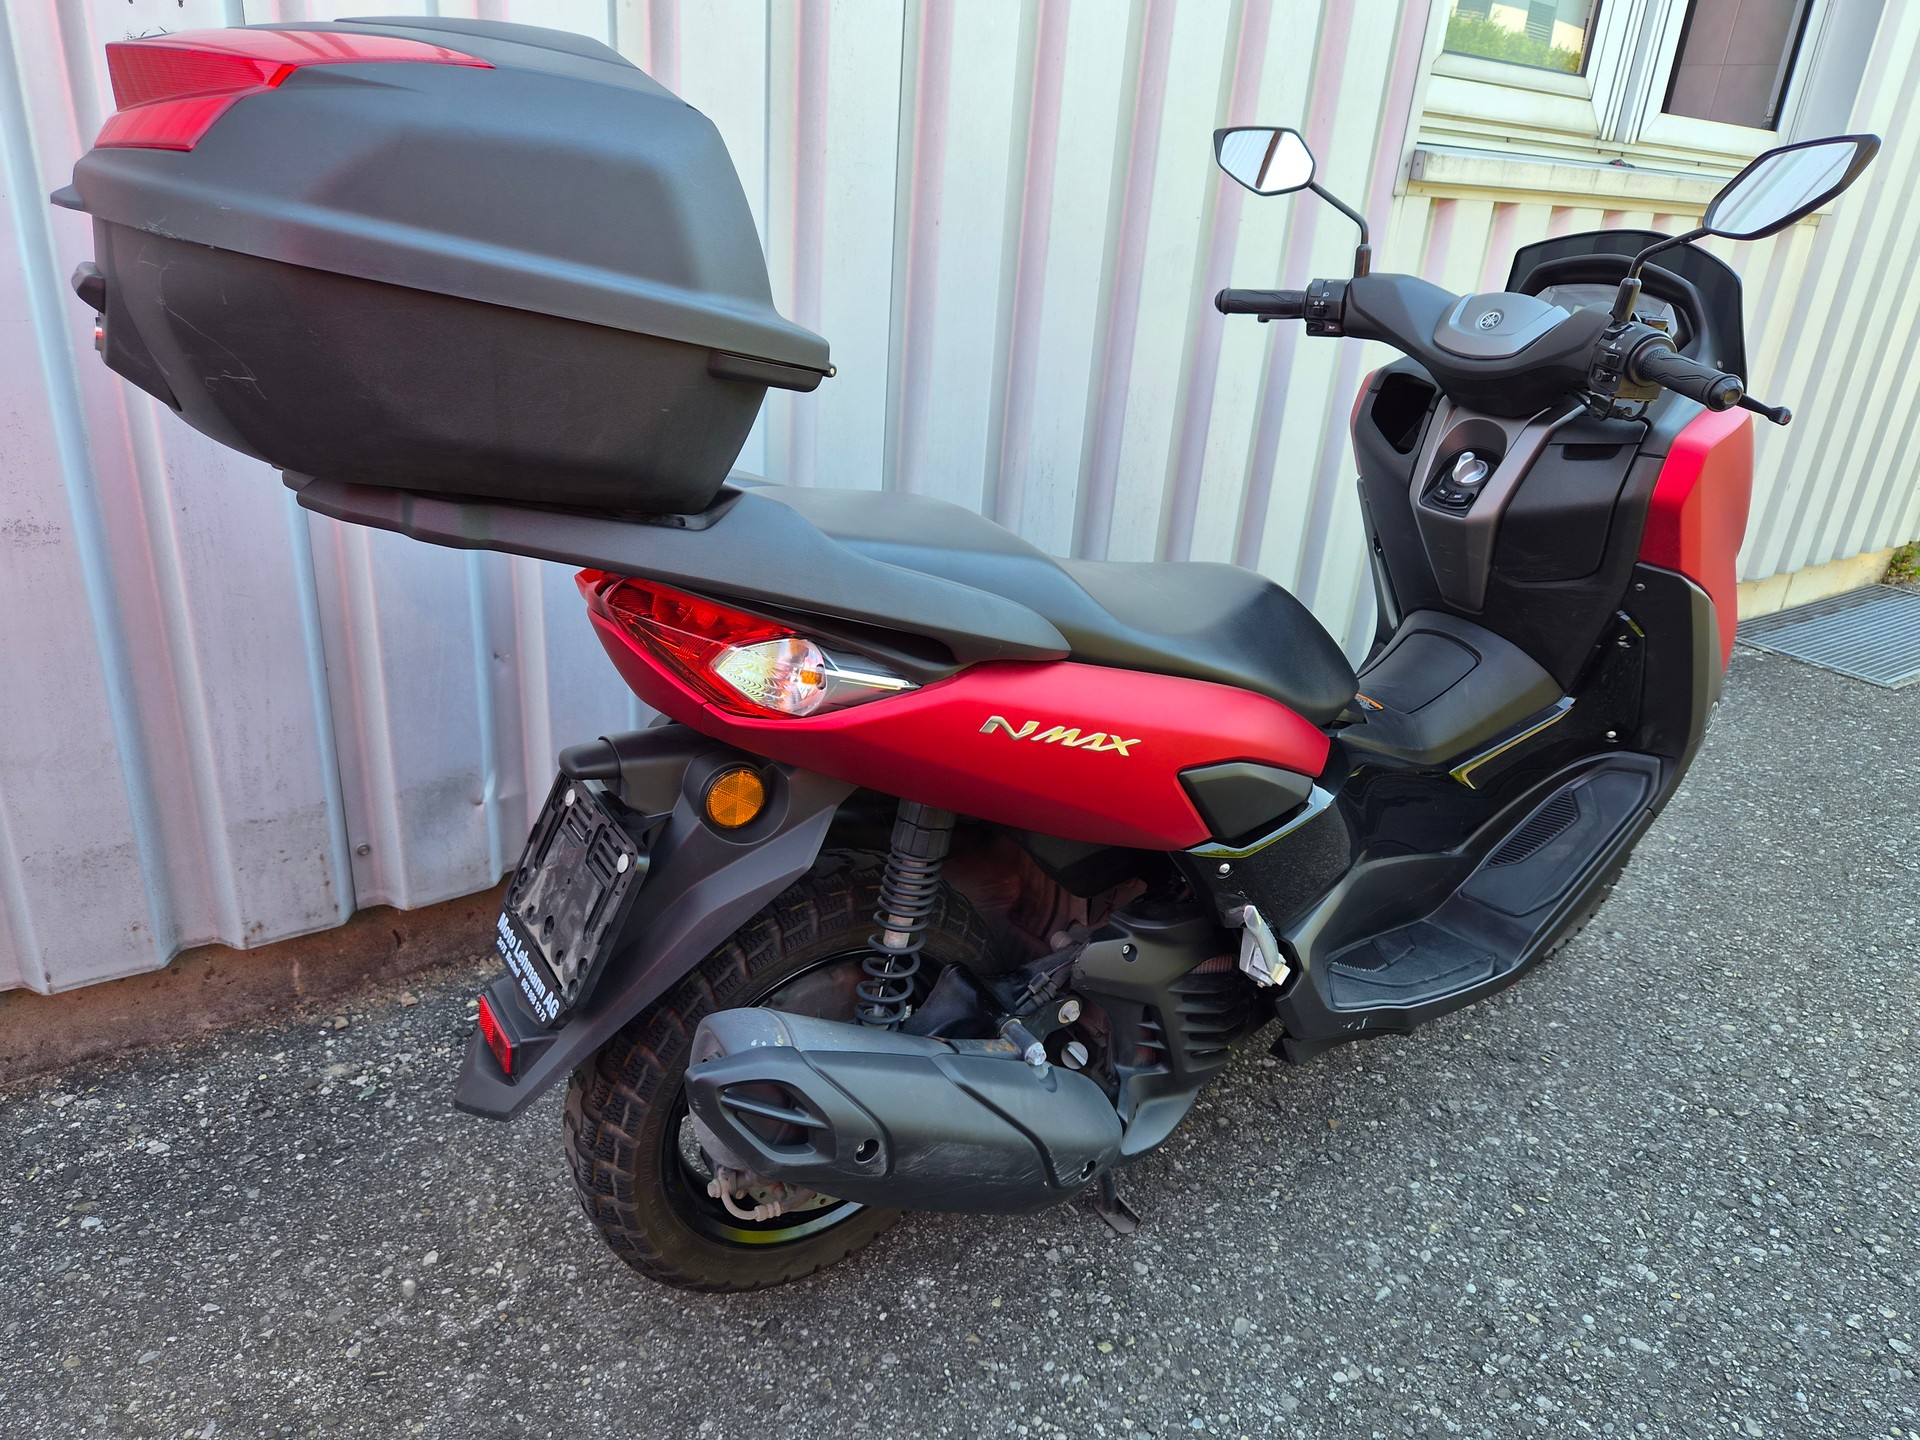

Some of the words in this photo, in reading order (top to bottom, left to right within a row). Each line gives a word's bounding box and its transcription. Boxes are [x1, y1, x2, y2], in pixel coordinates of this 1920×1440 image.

[979, 715, 1142, 757] NMAX
[497, 911, 517, 949] Moto
[513, 939, 546, 1000] Lehmann
[542, 990, 560, 1020] AG
